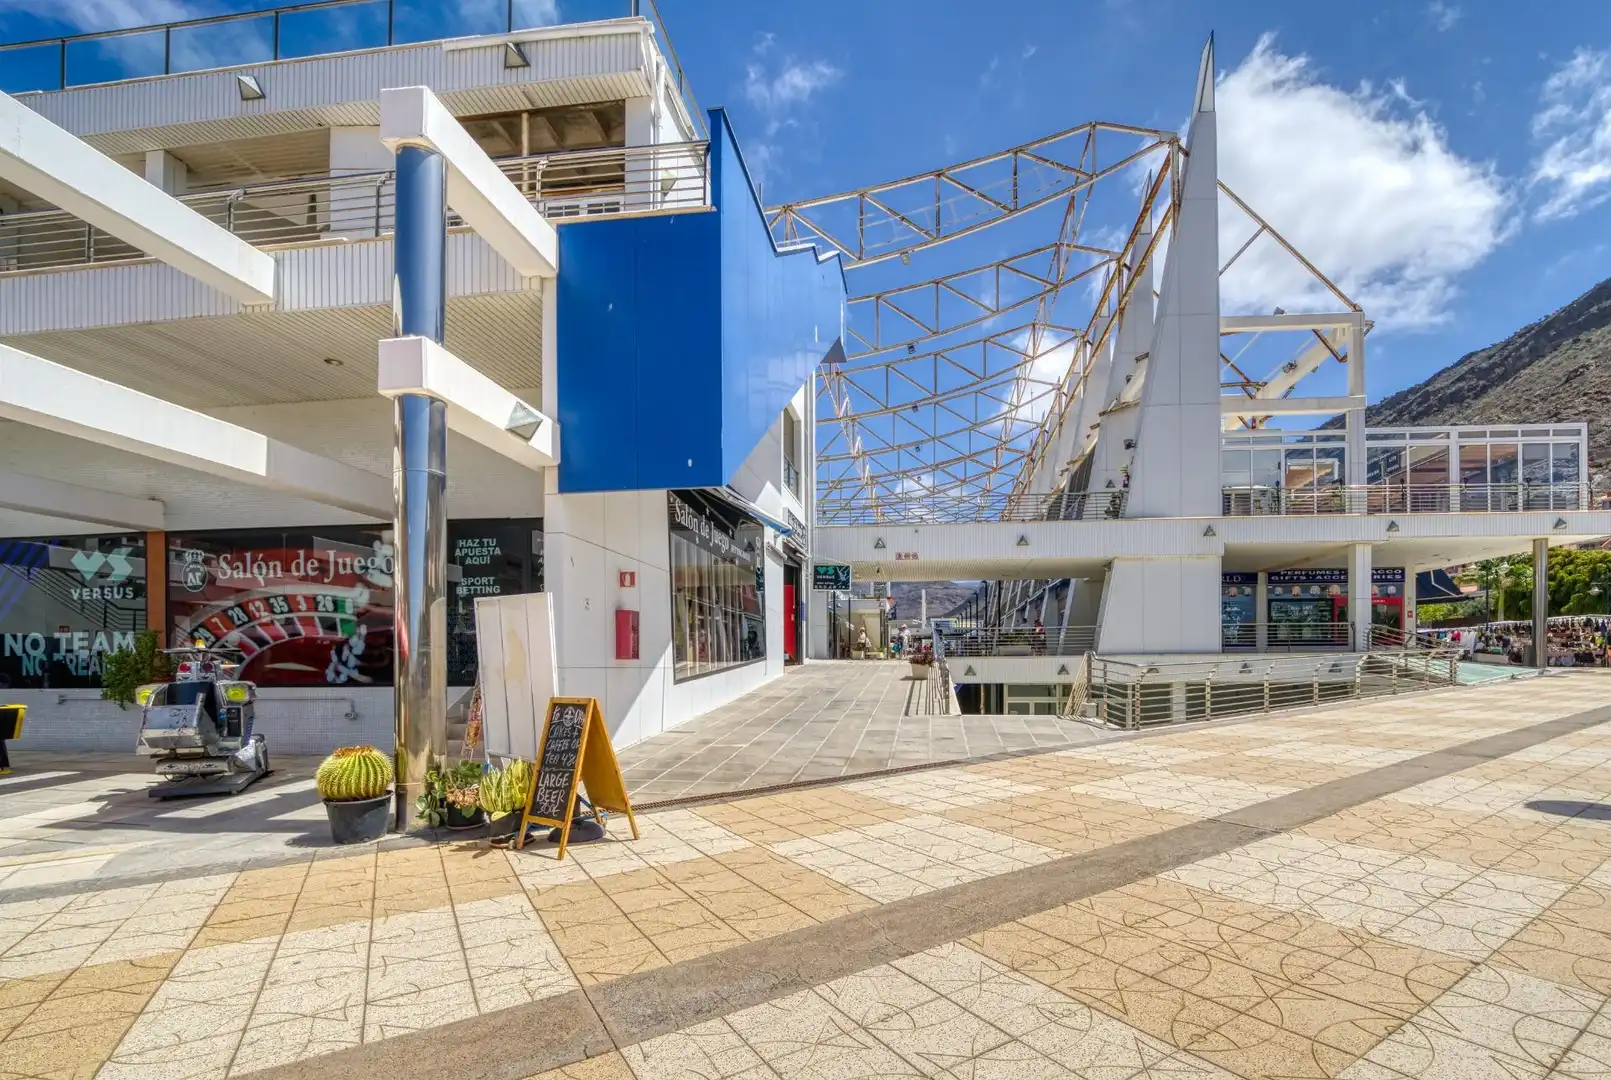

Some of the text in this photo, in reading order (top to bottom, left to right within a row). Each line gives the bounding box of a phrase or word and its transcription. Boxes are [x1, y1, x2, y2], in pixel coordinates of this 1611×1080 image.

[675, 499, 699, 533] Salón
[700, 514, 710, 539] de
[709, 520, 730, 554] Juego
[459, 538, 497, 548] HAZ TU
[454, 547, 501, 557] APUESTA
[465, 555, 490, 565] AQUÍ
[217, 552, 284, 580] Salón
[292, 550, 319, 577] de
[461, 576, 495, 586] SPORT
[70, 586, 134, 601] VERSUS
[455, 585, 501, 595] BETTING
[248, 600, 271, 620] 12
[269, 596, 290, 615] 35
[4, 630, 137, 657] NO TEAM
[538, 770, 570, 789] LARGE
[536, 787, 566, 803] BEER
